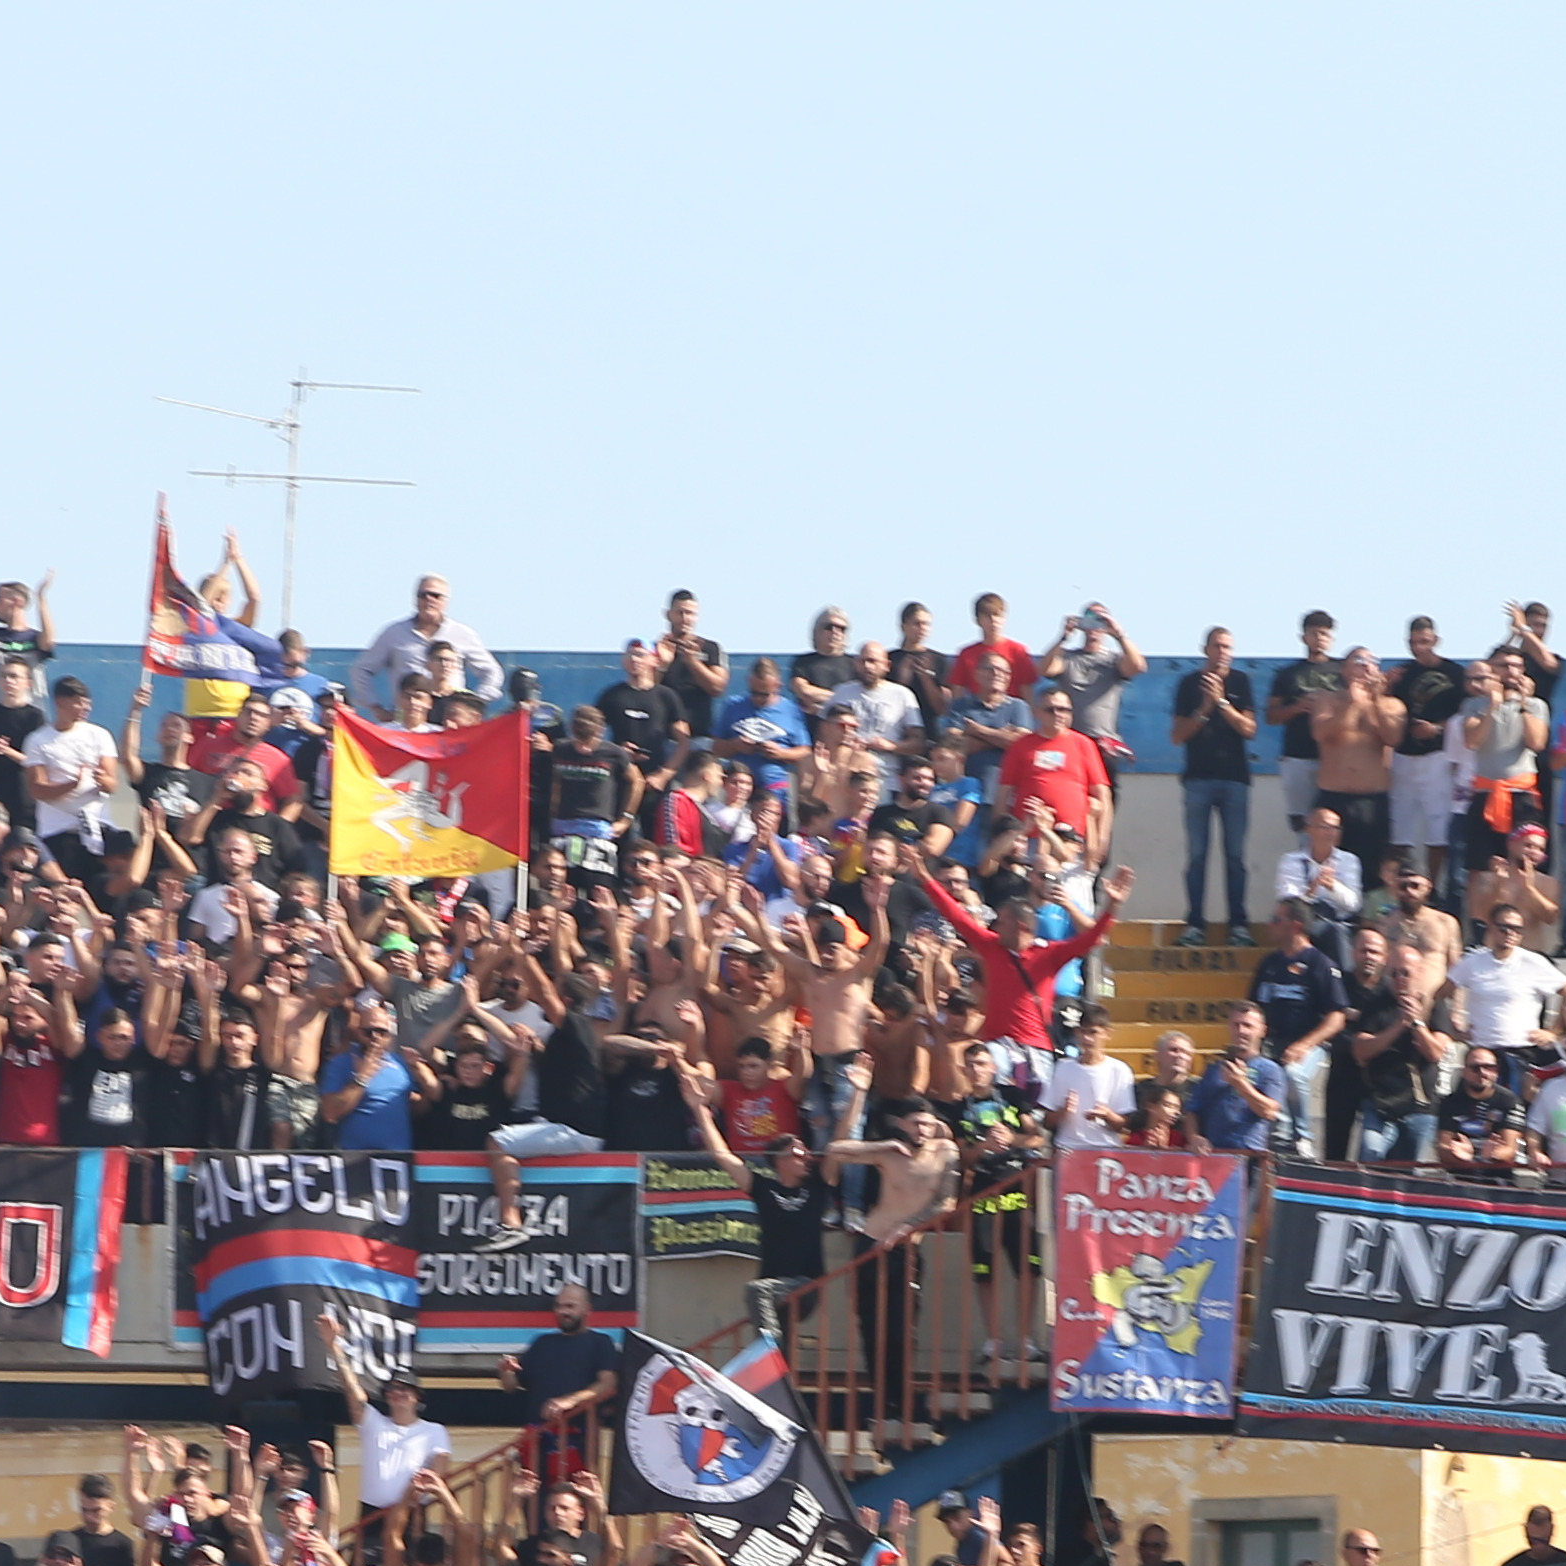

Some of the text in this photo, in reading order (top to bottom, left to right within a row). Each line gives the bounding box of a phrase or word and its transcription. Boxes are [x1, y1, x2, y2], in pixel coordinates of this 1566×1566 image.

[194, 1154, 411, 1241] ANGELO
[1094, 1157, 1217, 1203] Panza
[437, 1193, 570, 1239] PIAZA
[1064, 1193, 1236, 1242] Presenza
[207, 1299, 305, 1397] CON
[1271, 1307, 1511, 1405] VIVE
[1052, 1358, 1233, 1408] Sustanza
